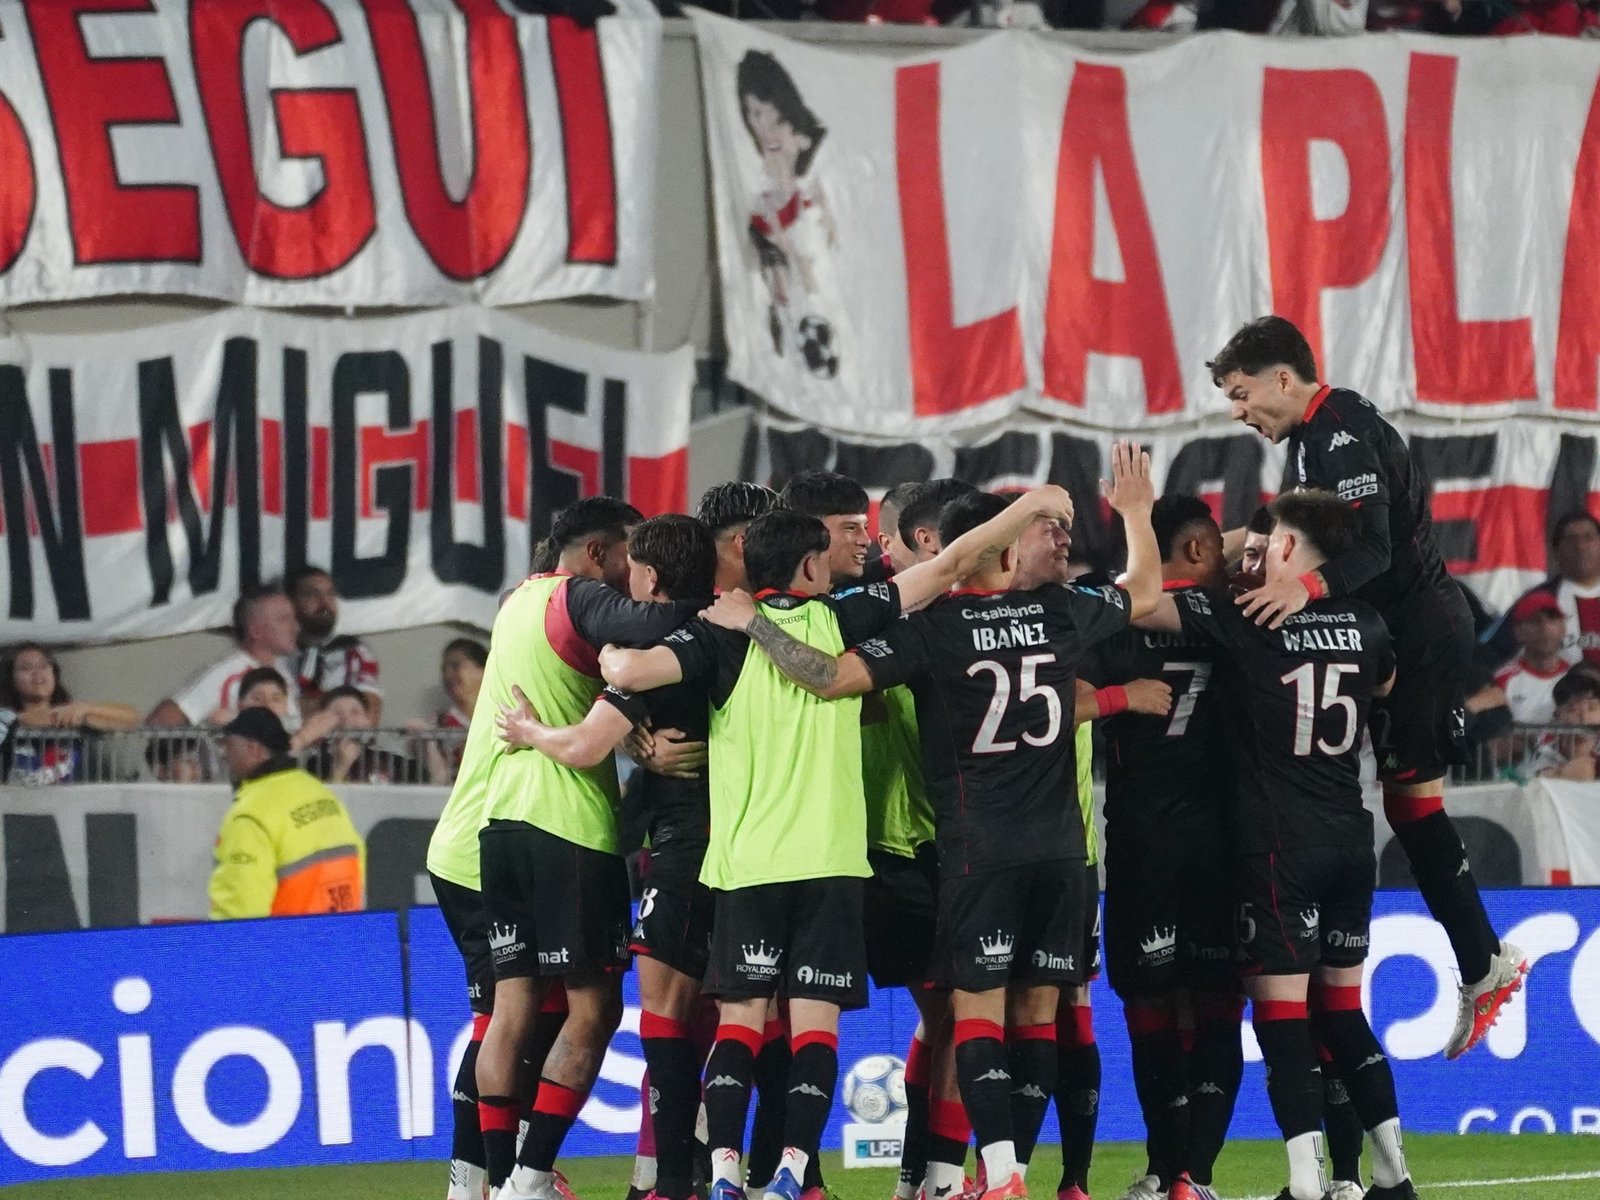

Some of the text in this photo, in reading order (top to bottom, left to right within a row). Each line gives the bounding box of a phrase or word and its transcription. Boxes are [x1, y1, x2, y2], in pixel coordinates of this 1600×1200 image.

[0, 0, 618, 282] EGUI
[895, 61, 1184, 418] LA
[1338, 473, 1377, 492] flecha
[961, 603, 1045, 621] Casablanca
[1282, 611, 1357, 628] asablanca
[972, 619, 1050, 651] IBAÑEZ
[1281, 628, 1363, 652] WALLER
[966, 653, 1062, 754] 25
[1163, 661, 1214, 738] 7
[1280, 662, 1361, 757] 15
[538, 947, 570, 964] mat
[814, 968, 853, 988] imat
[0, 976, 644, 1166] cions
[869, 1140, 901, 1157] LPF
